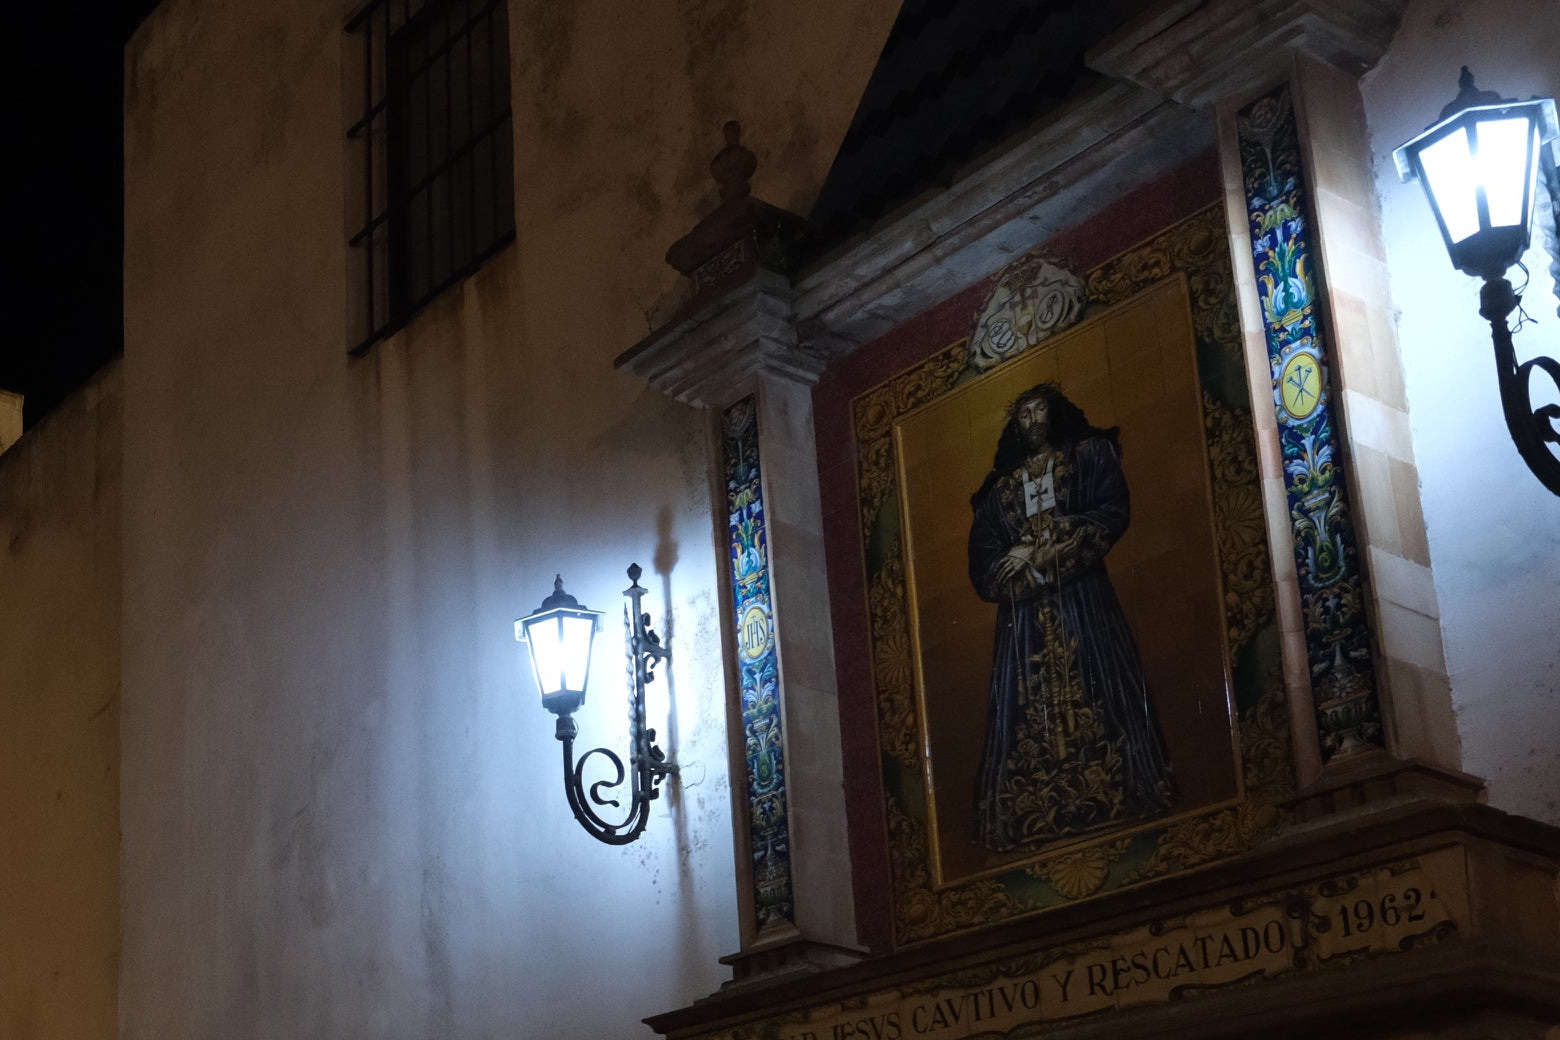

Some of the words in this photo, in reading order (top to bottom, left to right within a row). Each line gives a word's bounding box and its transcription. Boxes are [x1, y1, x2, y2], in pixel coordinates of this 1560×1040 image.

[1050, 969, 1075, 1003] Y
[1086, 919, 1287, 997] RESCATADO
[1340, 887, 1427, 938] 1962
